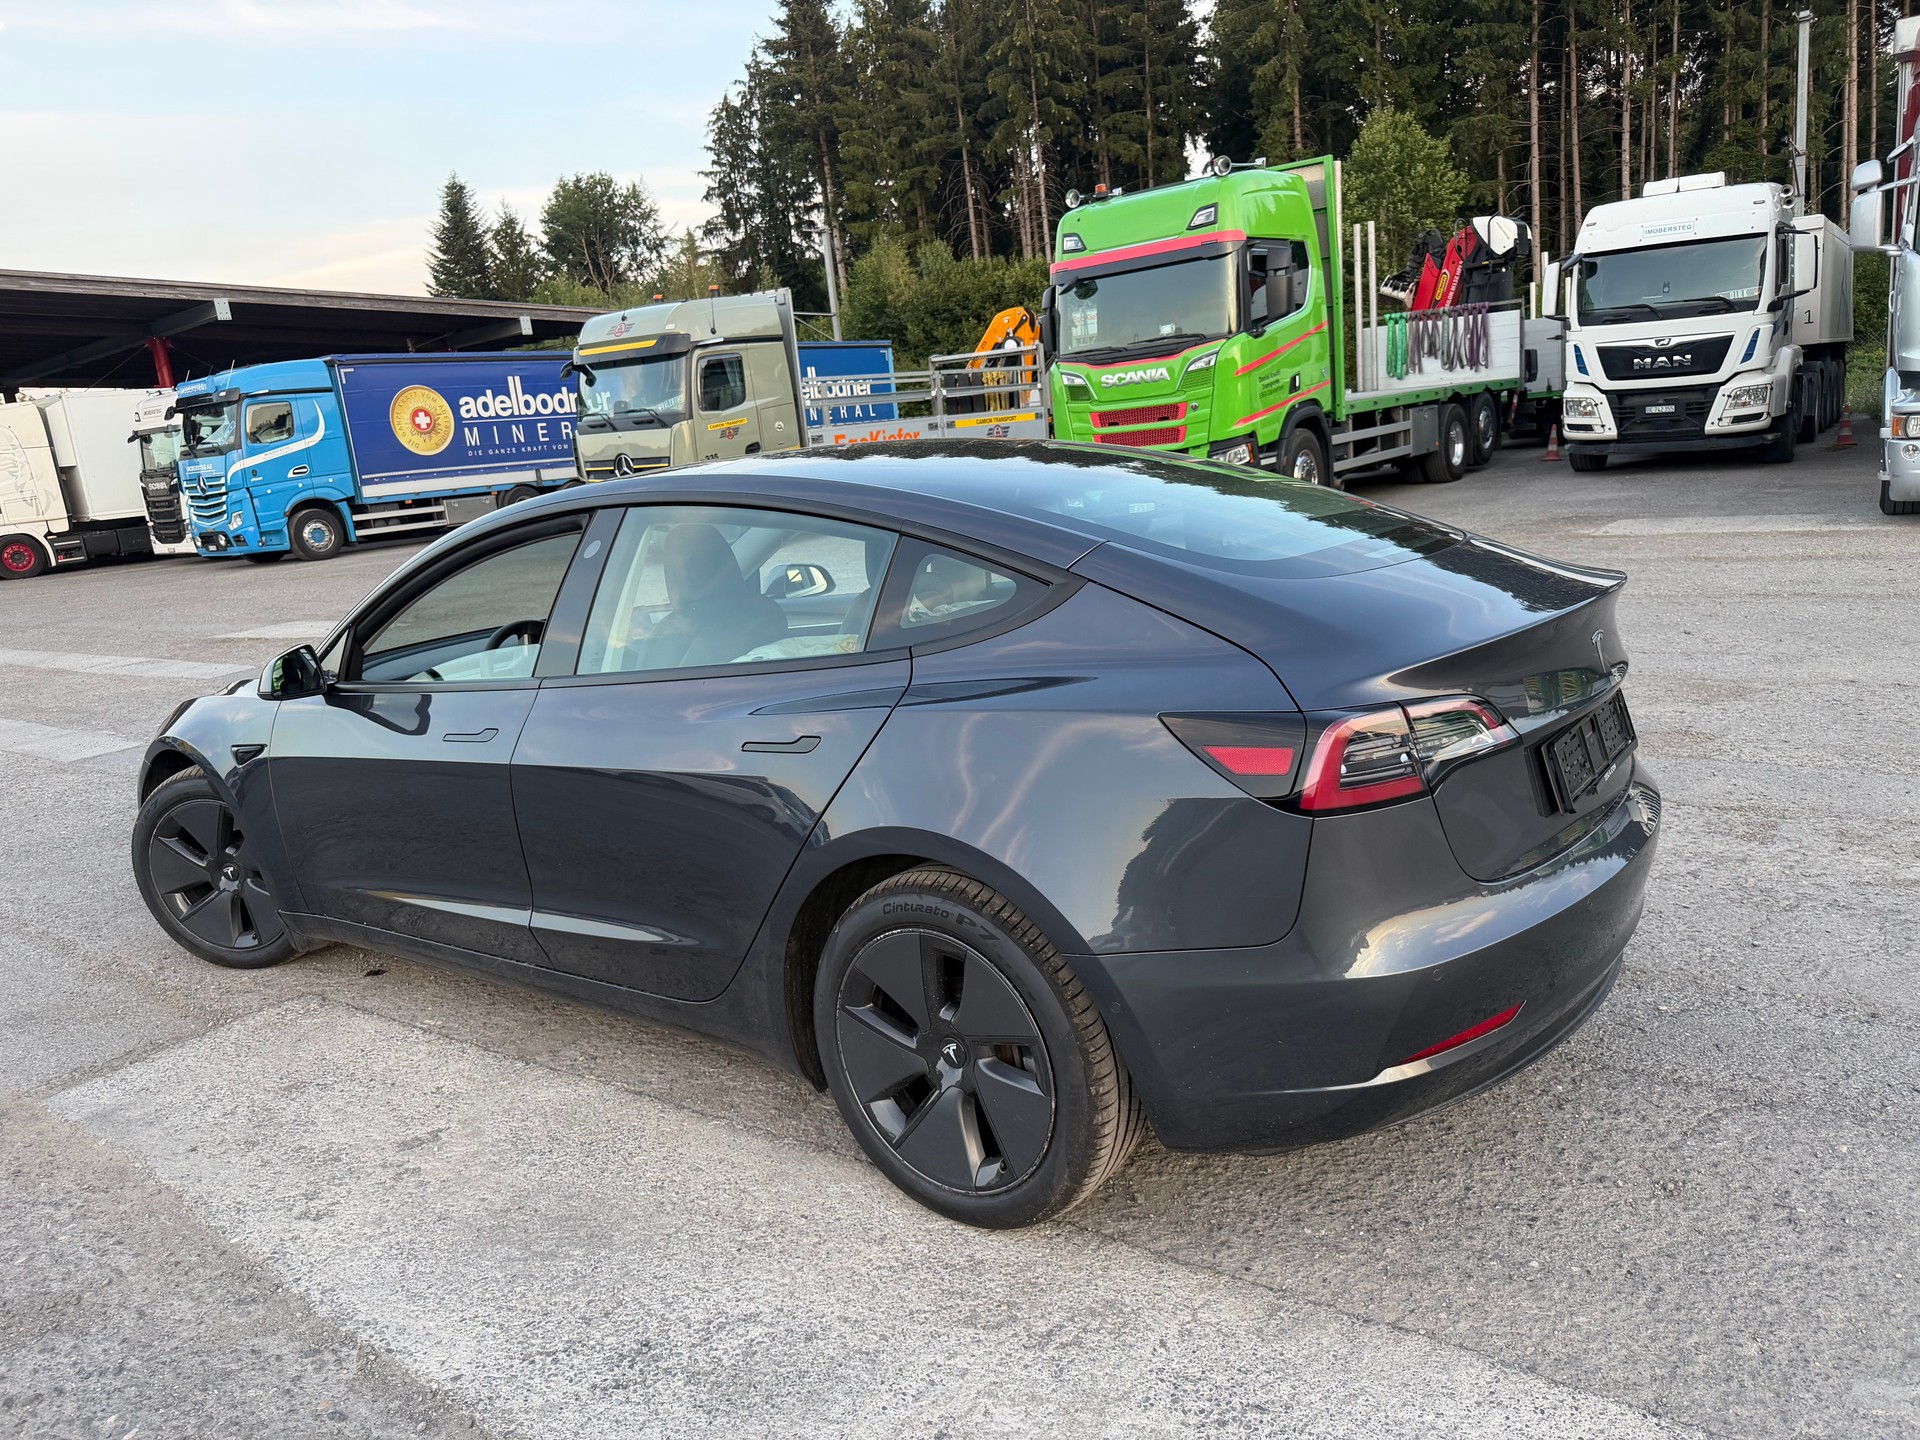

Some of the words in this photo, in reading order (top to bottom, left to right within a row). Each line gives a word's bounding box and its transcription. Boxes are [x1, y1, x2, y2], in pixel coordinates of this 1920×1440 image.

[1645, 224, 1692, 235] IMOBERSTEG
[1729, 289, 1748, 299] DIRK
[1804, 310, 1814, 324] 1
[1633, 354, 1692, 370] MAN
[801, 366, 873, 399] elbodner
[1101, 367, 1171, 388] SCANIA
[809, 403, 877, 421] NRAL
[993, 415, 1017, 423] TRANSPORT
[725, 418, 746, 427] TRANSPORT
[464, 421, 573, 447] MINER
[468, 449, 483, 457] DIE
[488, 447, 517, 455] GANZE
[522, 444, 547, 453] KRAFT
[882, 901, 950, 919] Cinturato
[955, 913, 1001, 941] P7
